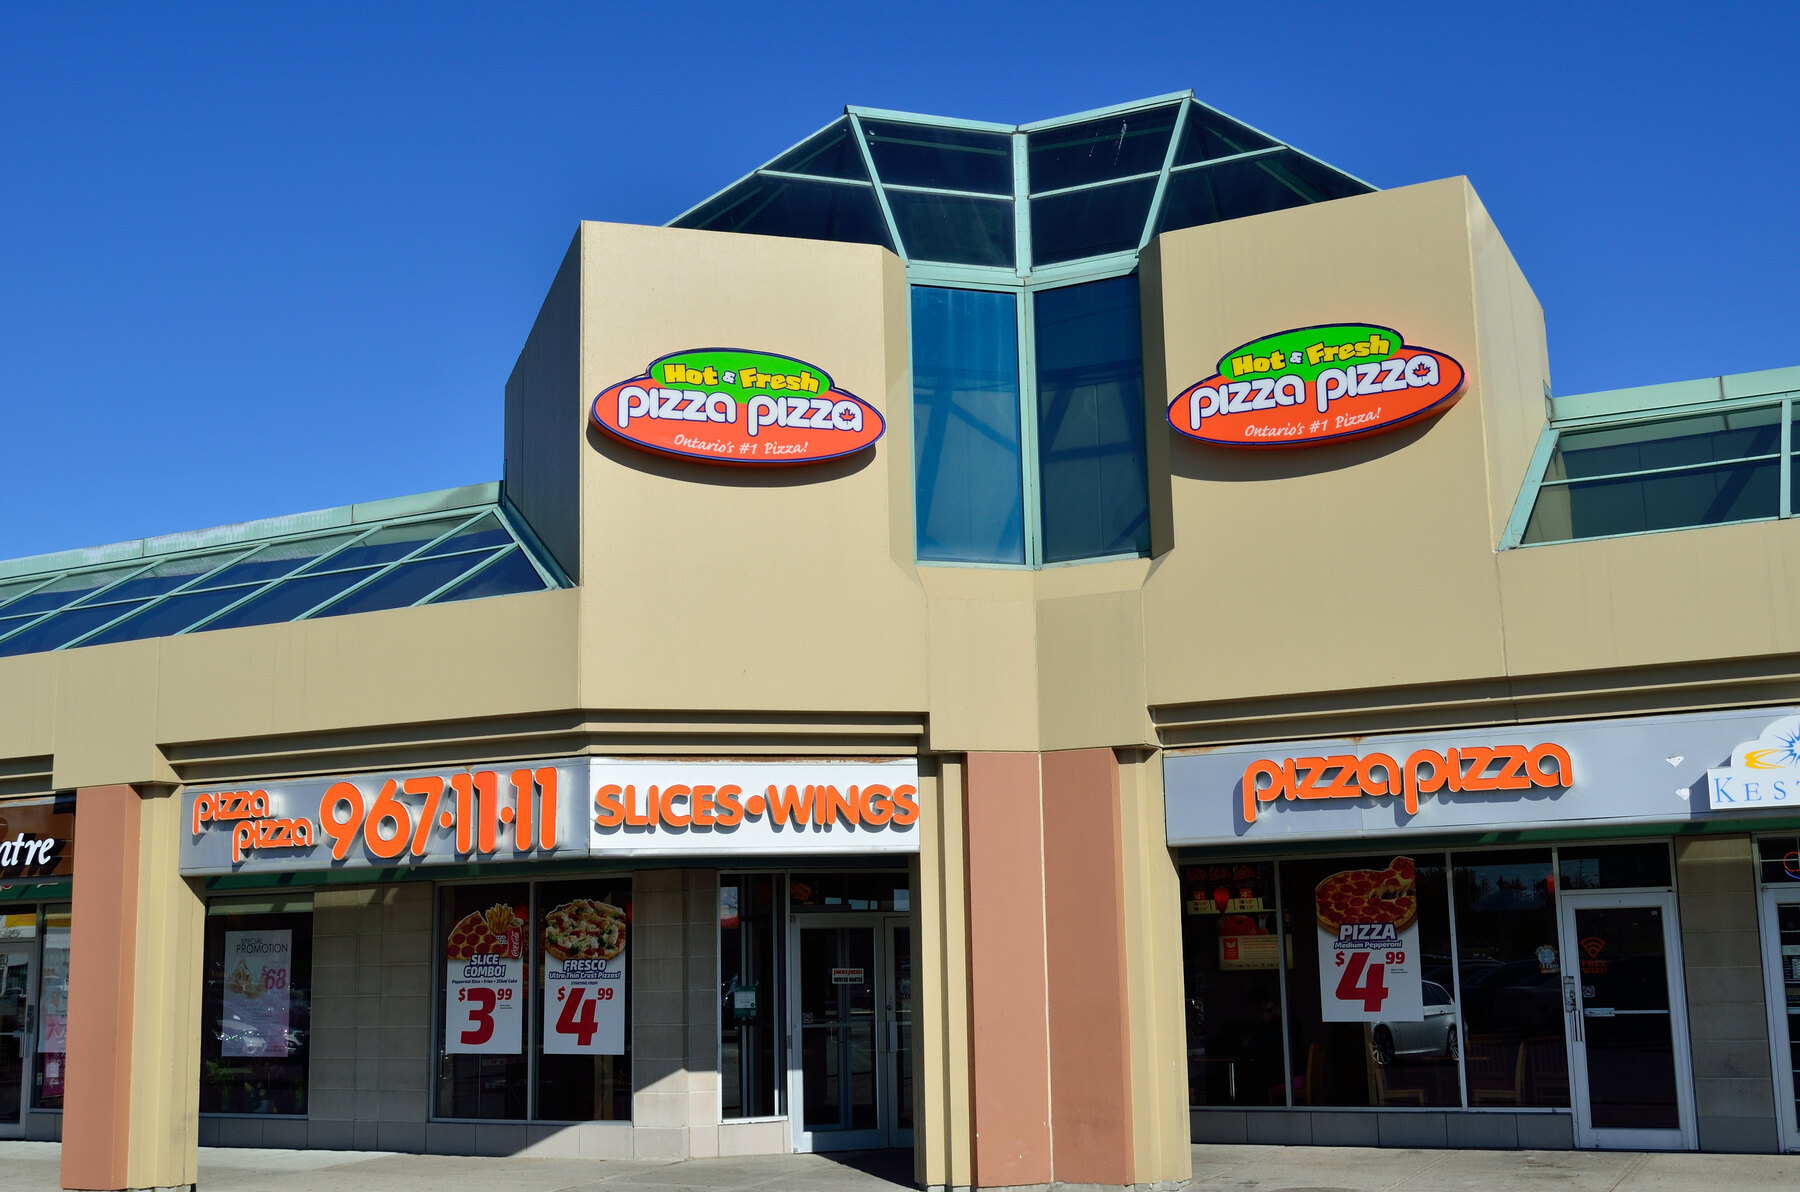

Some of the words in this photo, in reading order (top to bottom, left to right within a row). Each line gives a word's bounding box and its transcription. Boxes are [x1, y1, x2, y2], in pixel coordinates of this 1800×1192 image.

[1231, 351, 1286, 377] Hot
[1289, 351, 1303, 364] &
[1305, 334, 1391, 366] Fresh
[662, 364, 718, 385] Hot
[722, 371, 736, 384] &
[738, 367, 820, 393] Fresh
[1190, 374, 1306, 431] pizza
[1316, 354, 1440, 413] pizza
[618, 386, 737, 429] pizza
[747, 395, 863, 436] pizza
[1244, 422, 1305, 437] Ontario's
[1309, 420, 1328, 432] #1
[1335, 407, 1381, 429] Pizza!
[674, 433, 734, 455] Ontario's
[739, 443, 757, 455] #1
[764, 442, 808, 455] Pizza!
[1242, 752, 1400, 823] pizza
[1404, 742, 1574, 815] pizza
[1713, 777, 1800, 803] KES
[193, 789, 270, 835] pizza
[232, 817, 313, 863] pizza
[1334, 941, 1364, 949] Medium
[1364, 940, 1402, 950] Pepperoni
[1339, 924, 1396, 940] PIZZA
[236, 943, 288, 954] PROMOTION
[470, 953, 500, 965] SLICE
[464, 965, 506, 977] COMBO!
[549, 971, 567, 979] Ultra
[566, 971, 580, 979] Thin
[580, 971, 597, 979] Crust
[598, 971, 621, 979] Pizzas!
[563, 959, 607, 972] FRESCO
